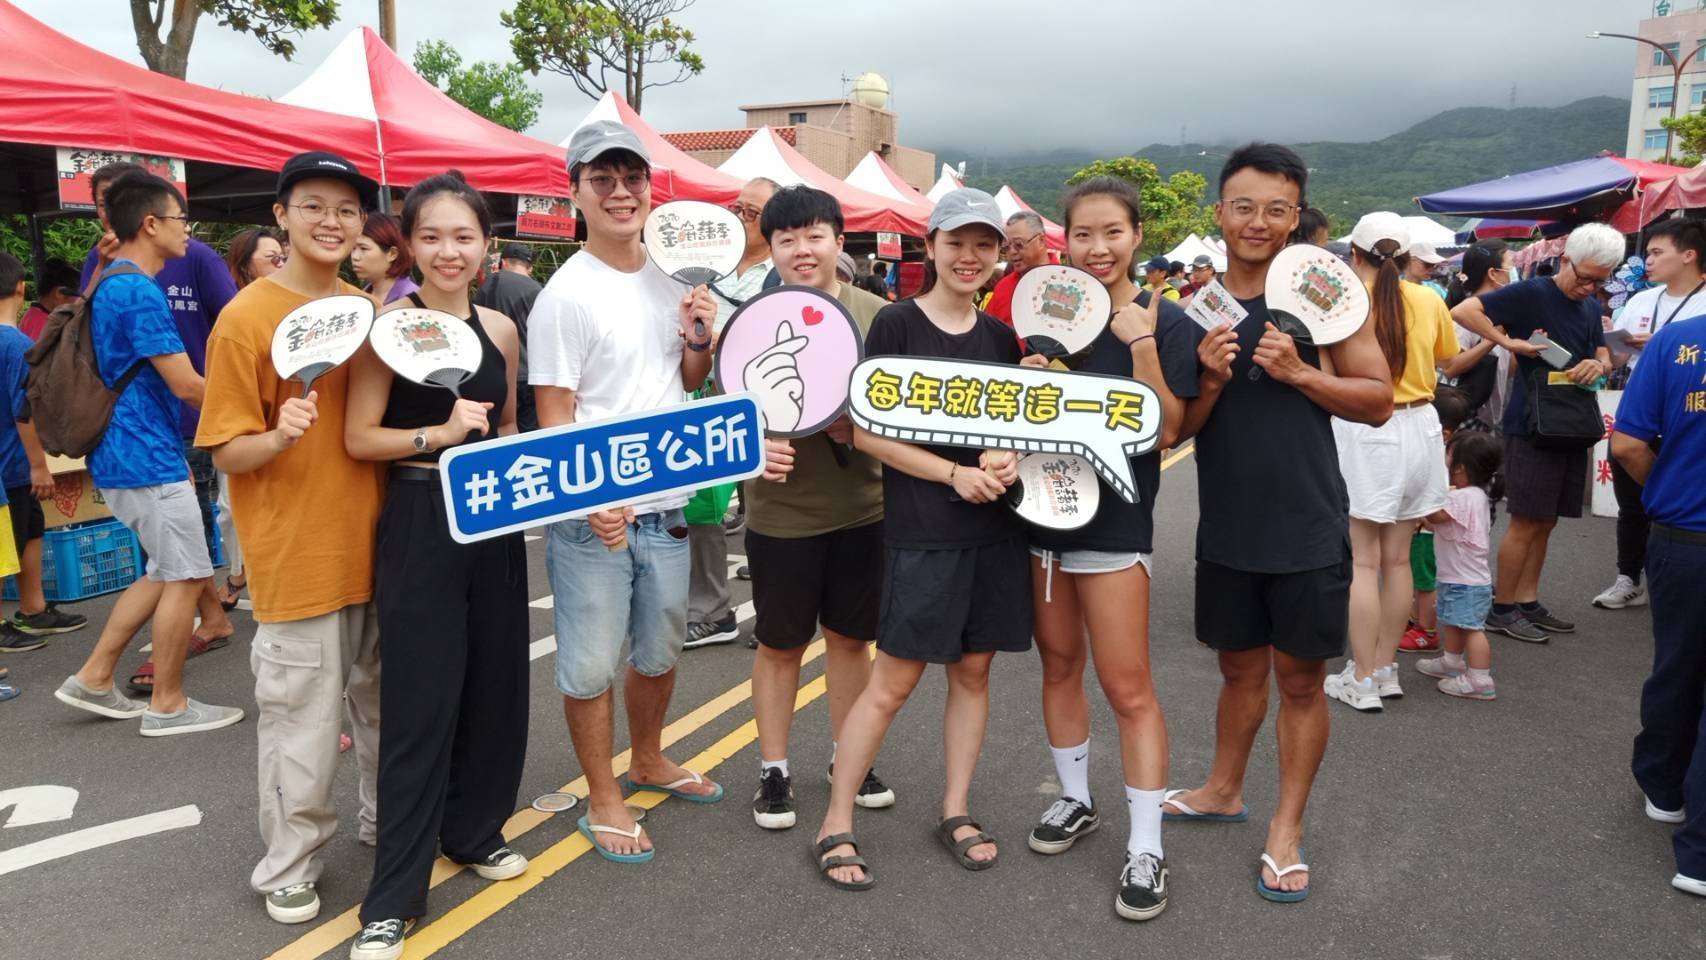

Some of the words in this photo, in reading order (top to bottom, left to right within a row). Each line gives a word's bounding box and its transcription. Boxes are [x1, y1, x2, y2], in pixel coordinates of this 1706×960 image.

[167, 285, 192, 297] 金山
[866, 367, 1146, 432] 每年就等這一天
[464, 412, 748, 515] #金山區公所
